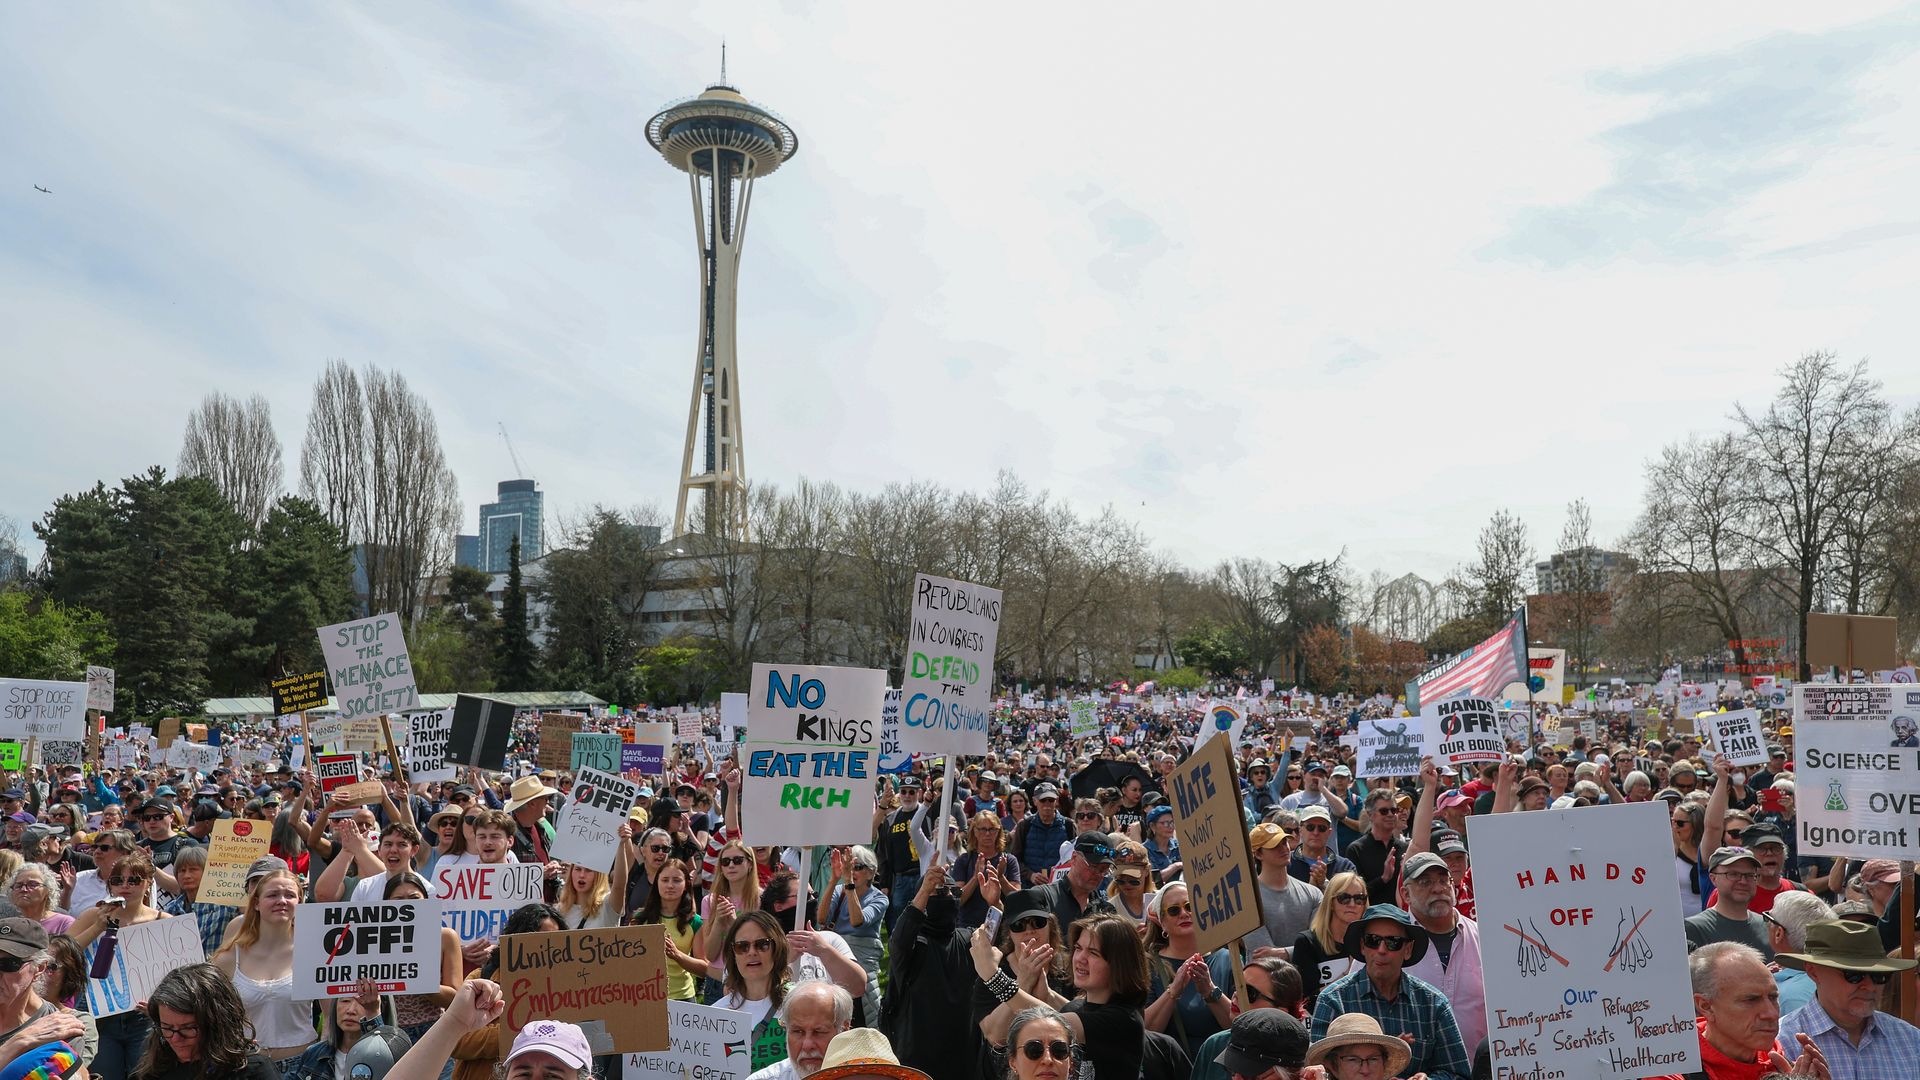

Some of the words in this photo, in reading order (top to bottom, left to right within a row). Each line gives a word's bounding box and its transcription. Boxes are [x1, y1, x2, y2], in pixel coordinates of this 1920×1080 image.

[918, 579, 999, 621] REPUBLICANS
[336, 619, 389, 647] STOP
[912, 619, 927, 642] IN
[930, 622, 984, 651] CONGRESS
[356, 643, 383, 659] THE
[335, 654, 408, 688] MENACE
[911, 652, 979, 685] DEFEND
[272, 676, 303, 688] Somebody's
[304, 671, 325, 681] Hurting
[290, 683, 308, 693] People
[309, 680, 319, 689] and
[365, 681, 383, 694] TO
[9, 687, 43, 704] STOP
[45, 690, 76, 704] DOGE
[283, 696, 292, 704] We
[292, 692, 309, 702] Won't
[309, 690, 317, 698] Be
[766, 670, 827, 710] NO
[942, 684, 965, 696] THE
[281, 704, 297, 714] Silent
[298, 700, 321, 711] Anymore
[342, 684, 416, 719] SOCIETY
[1438, 699, 1494, 716] HANDS
[1826, 701, 1869, 713] OFF!
[4, 705, 32, 720] STOP
[34, 705, 72, 720] TRUMP
[1716, 717, 1750, 728] HANDS
[25, 723, 44, 734] HANDS
[46, 722, 62, 733] OFF!
[412, 714, 443, 732] STOP
[796, 713, 873, 746] KINGS
[1440, 712, 1499, 736] OFF!
[1719, 723, 1752, 737] OFF!
[413, 743, 448, 758] MUSK
[572, 736, 602, 751] HANDS
[606, 737, 619, 752] OFF
[1359, 736, 1376, 747] NEW
[1439, 740, 1466, 755] OUR
[1467, 739, 1504, 754] BODIES
[1720, 736, 1760, 753] FAIR
[575, 751, 613, 770] IMLS
[623, 749, 642, 757] SAVE
[623, 755, 660, 763] MEDICAID
[1723, 750, 1761, 760] ELECTIONS
[1806, 749, 1900, 771] SCIENCE
[319, 761, 354, 777] RESIST
[749, 750, 804, 777] EAT
[811, 751, 868, 779] THE
[580, 769, 635, 797] HANDS
[1173, 761, 1216, 821] HATE
[574, 784, 632, 818] OFF!
[780, 783, 851, 810] RICH
[570, 824, 616, 847] TRUMP
[1803, 821, 1907, 848] Ignorant
[214, 844, 259, 853] TRUMP/MUSK
[1191, 854, 1215, 878] MAKE
[1215, 837, 1232, 860] US
[216, 879, 247, 888] SOCIAL
[436, 868, 495, 900] SAVE
[499, 865, 542, 900] OUR
[1516, 863, 1647, 890] HANDS
[1193, 863, 1243, 932] GREAT
[324, 904, 415, 925] HANDS
[1550, 908, 1594, 926] OFF
[122, 917, 199, 967] KINGS
[323, 925, 415, 956] OFF!
[507, 936, 573, 972] United
[579, 934, 647, 965] States
[315, 965, 352, 983] OUR
[357, 963, 418, 981] BODIES
[577, 967, 591, 984] of
[507, 968, 667, 1033] Embarrassment
[1563, 988, 1598, 1006] Our
[1495, 1004, 1573, 1037] Immigrants
[1602, 997, 1650, 1024] Refugees
[1553, 1025, 1615, 1051] Scientists
[1633, 1014, 1695, 1040] Researchers
[670, 1036, 711, 1057] MAKE
[630, 1053, 686, 1076] AMERICA
[692, 1064, 737, 1080] GREAT
[1609, 1046, 1687, 1073] Healthcare
